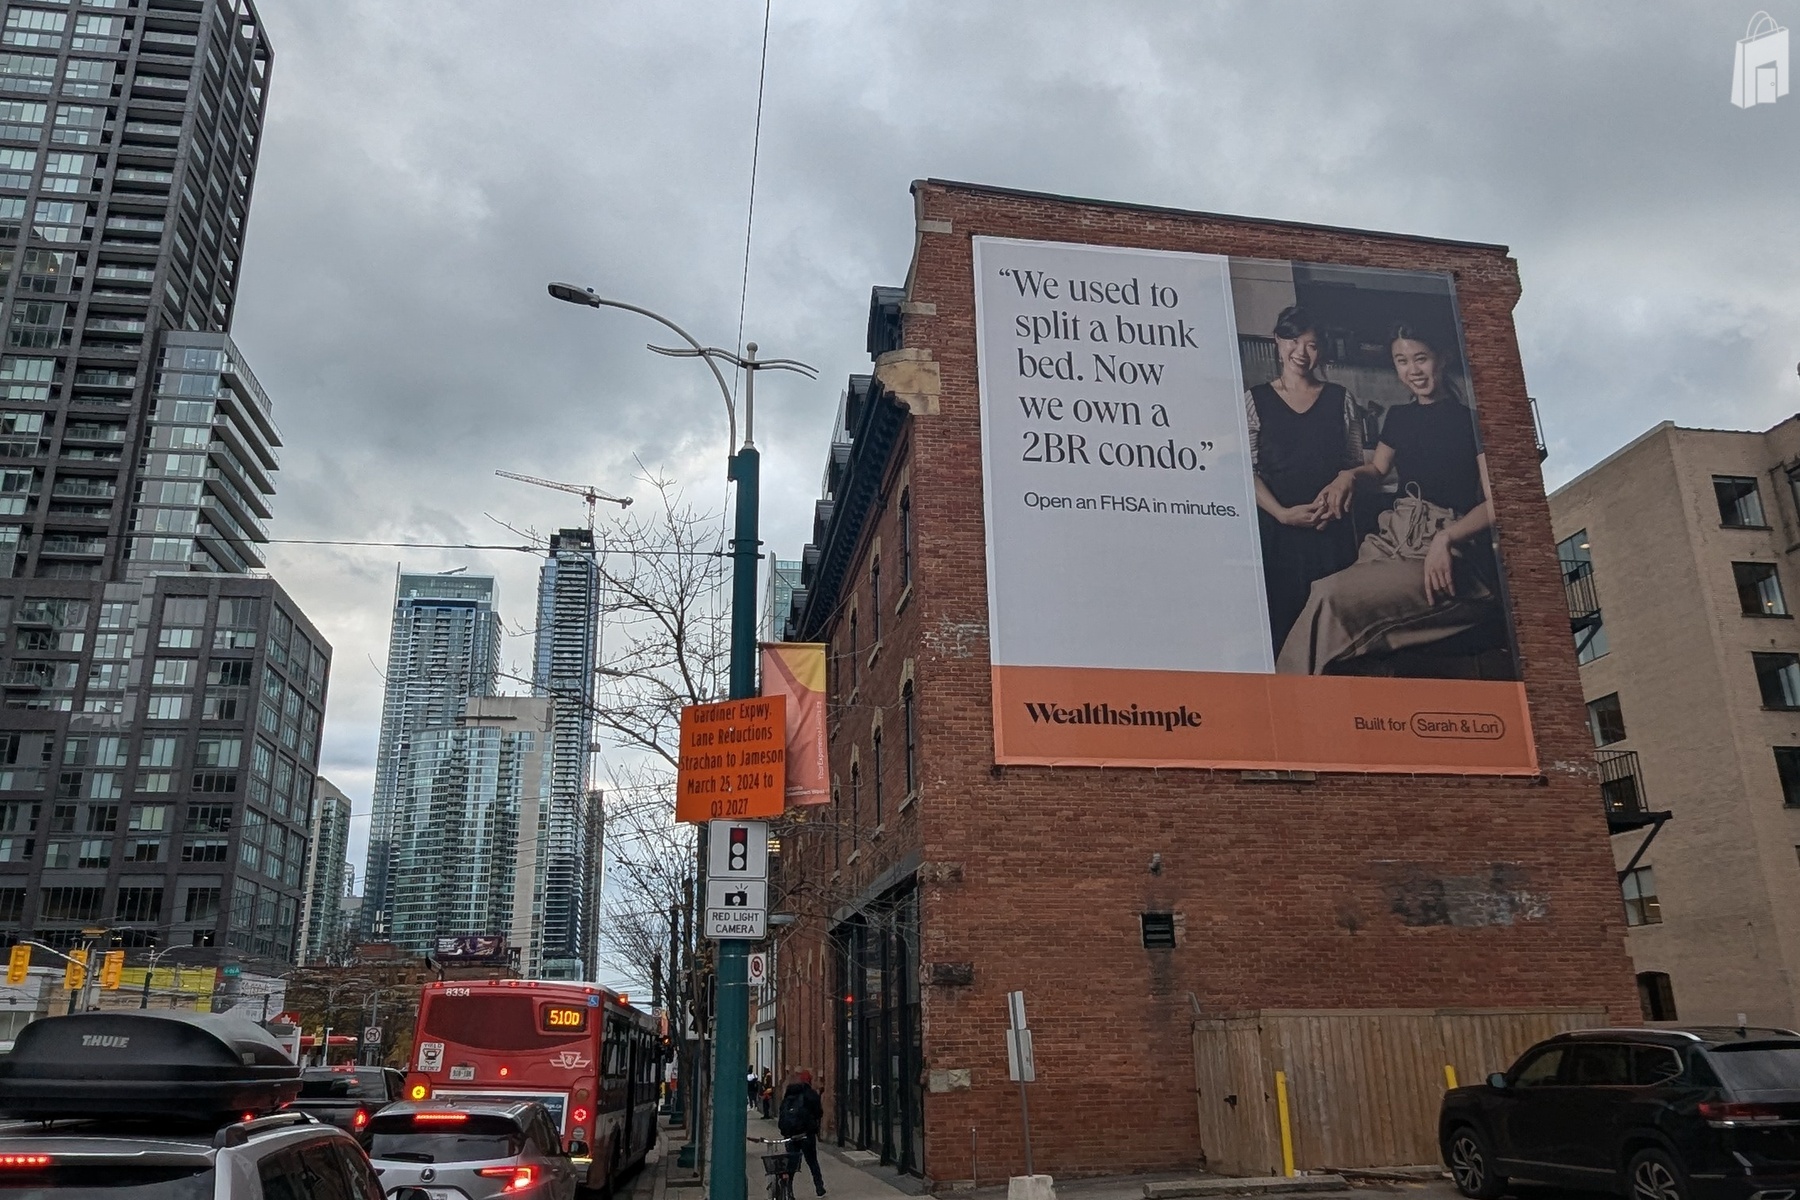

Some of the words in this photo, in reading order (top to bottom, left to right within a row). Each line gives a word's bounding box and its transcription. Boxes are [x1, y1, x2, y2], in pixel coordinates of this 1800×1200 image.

[999, 268, 1059, 300] “We
[1069, 278, 1140, 305] used
[1151, 283, 1178, 308] to
[1015, 310, 1080, 345] split
[1090, 320, 1108, 342] a
[1116, 315, 1199, 348] bunk
[1018, 348, 1083, 380] bed.
[1092, 354, 1165, 385] Now
[1019, 396, 1063, 421] we
[1073, 399, 1141, 425] own
[1151, 403, 1170, 427] a
[1022, 431, 1091, 464] 2BR
[1099, 439, 1213, 471] condo.”
[1024, 492, 1071, 510] Open
[1076, 498, 1097, 510] an
[1101, 495, 1150, 512] FHSA
[1153, 498, 1167, 513] in
[1171, 500, 1240, 517] minutes.
[694, 705, 736, 723] Gardiner
[740, 703, 772, 721] Expwy.
[1024, 702, 1202, 732] Wealthsimple
[691, 732, 714, 747] Lane
[718, 724, 772, 744] Reductions
[1354, 717, 1385, 731] Built
[1388, 718, 1406, 731] for
[1417, 718, 1457, 732] Sarah
[1461, 720, 1470, 733] &
[1473, 720, 1499, 733] Lori
[680, 753, 722, 771] Strachan
[726, 751, 736, 768] to
[740, 749, 783, 766] Jameson
[688, 776, 716, 794] March
[737, 773, 759, 790] 2024
[763, 772, 773, 788] to
[711, 800, 722, 817] Q3
[726, 798, 748, 815] 2027
[712, 912, 730, 921] RED
[733, 912, 759, 921] LIGHT
[715, 924, 755, 933] CAMERA
[445, 988, 470, 997] 8334
[550, 1010, 580, 1025] 510D
[82, 1035, 129, 1048] THULE
